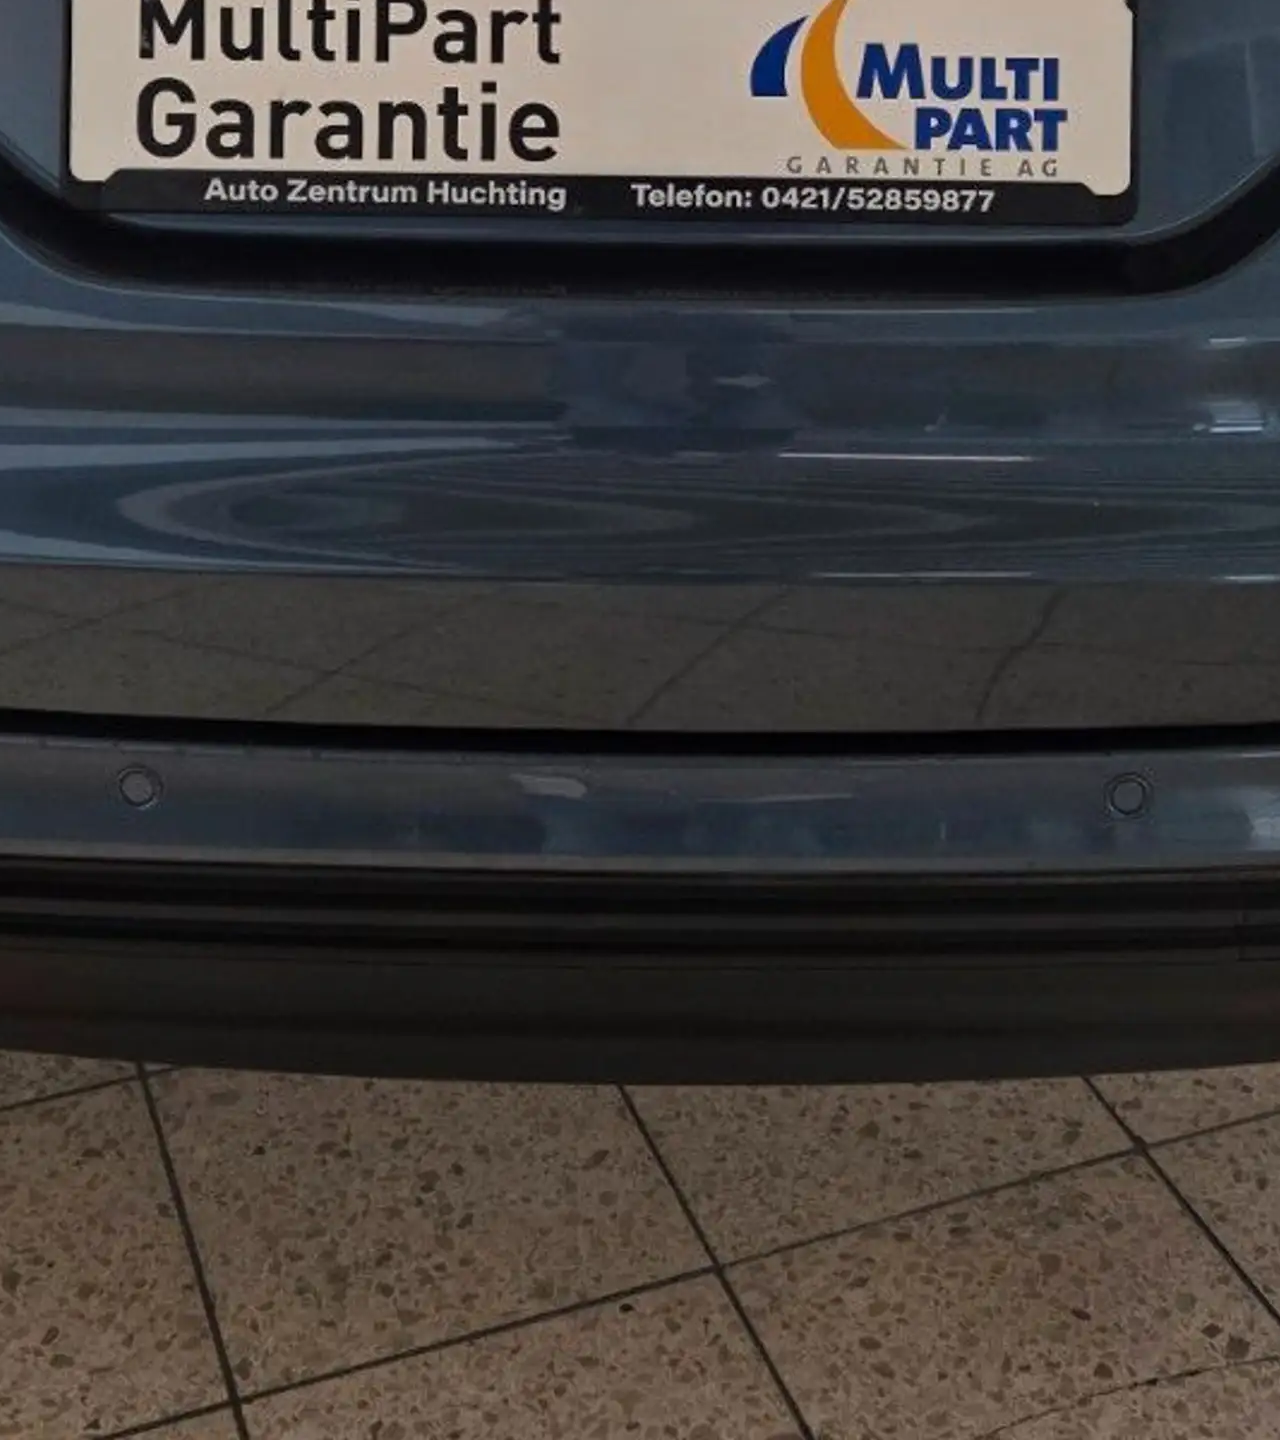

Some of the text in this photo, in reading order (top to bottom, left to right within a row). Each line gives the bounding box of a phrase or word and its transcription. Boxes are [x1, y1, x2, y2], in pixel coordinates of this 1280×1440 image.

[856, 42, 1060, 101] MULTI
[136, 76, 561, 161] Garantie
[914, 107, 1069, 152] PART
[786, 155, 1058, 178] GARANTIE AG
[204, 177, 995, 213] Auto Zentrum Huchting Telefon: 0421/52859877
